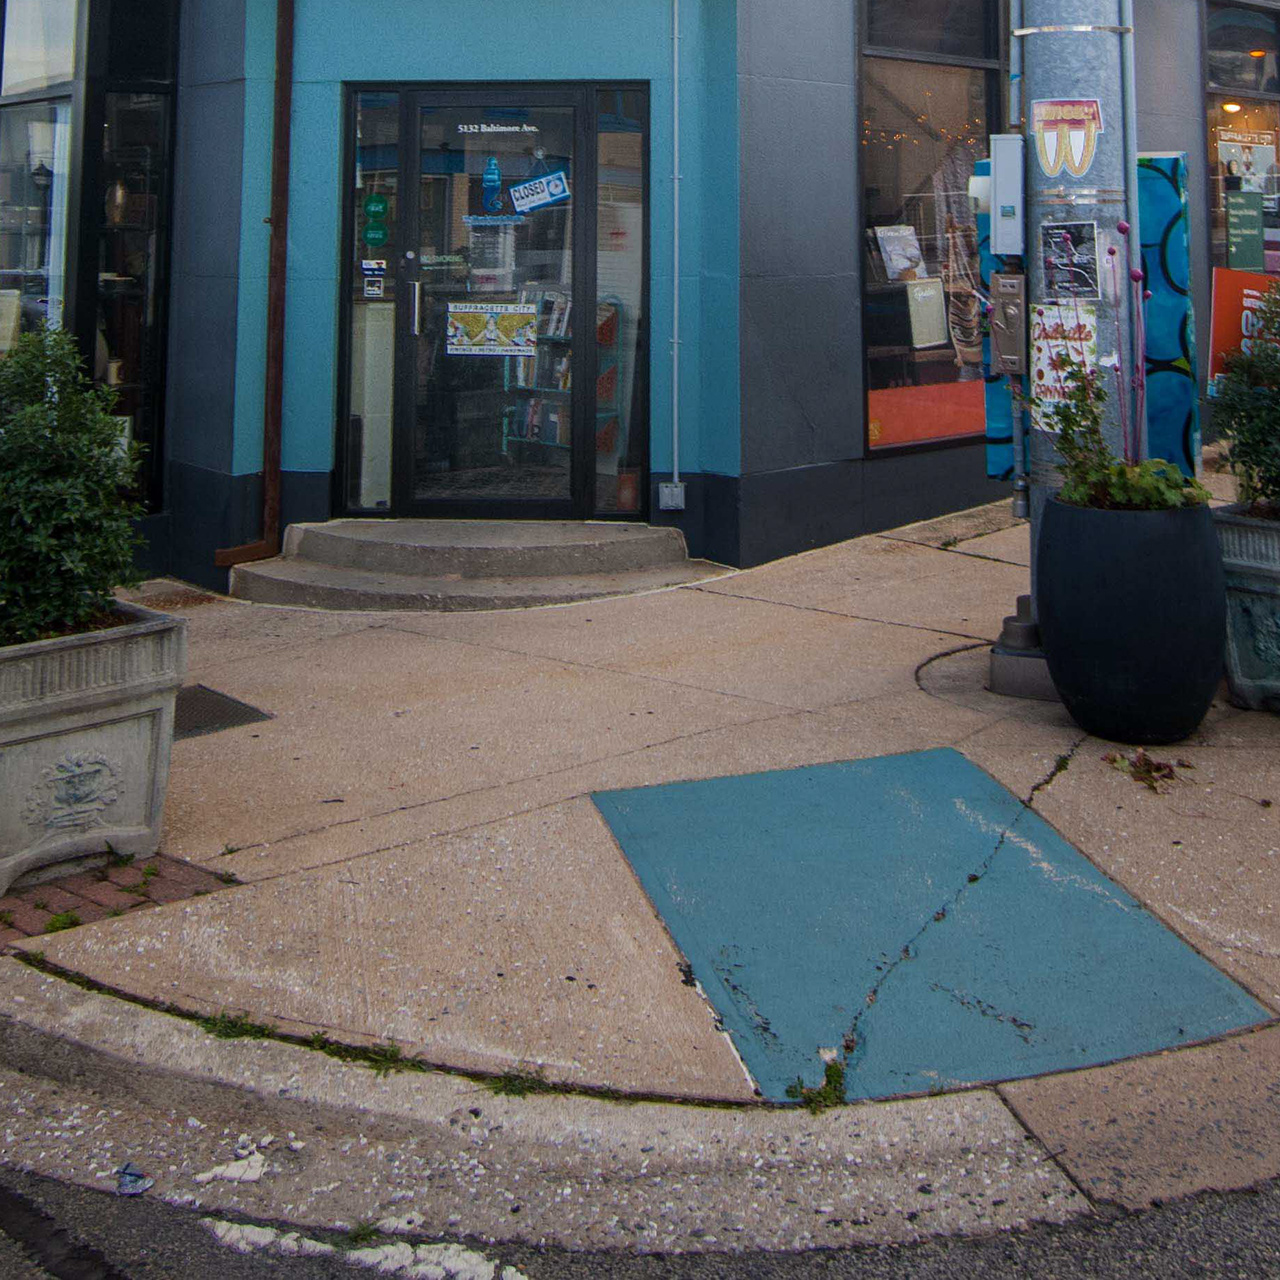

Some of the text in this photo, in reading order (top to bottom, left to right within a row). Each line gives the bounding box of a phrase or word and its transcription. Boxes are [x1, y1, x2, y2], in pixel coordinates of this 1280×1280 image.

[458, 124, 479, 133] 5132
[480, 124, 520, 132] Baltimore
[512, 180, 546, 202] CLOSED
